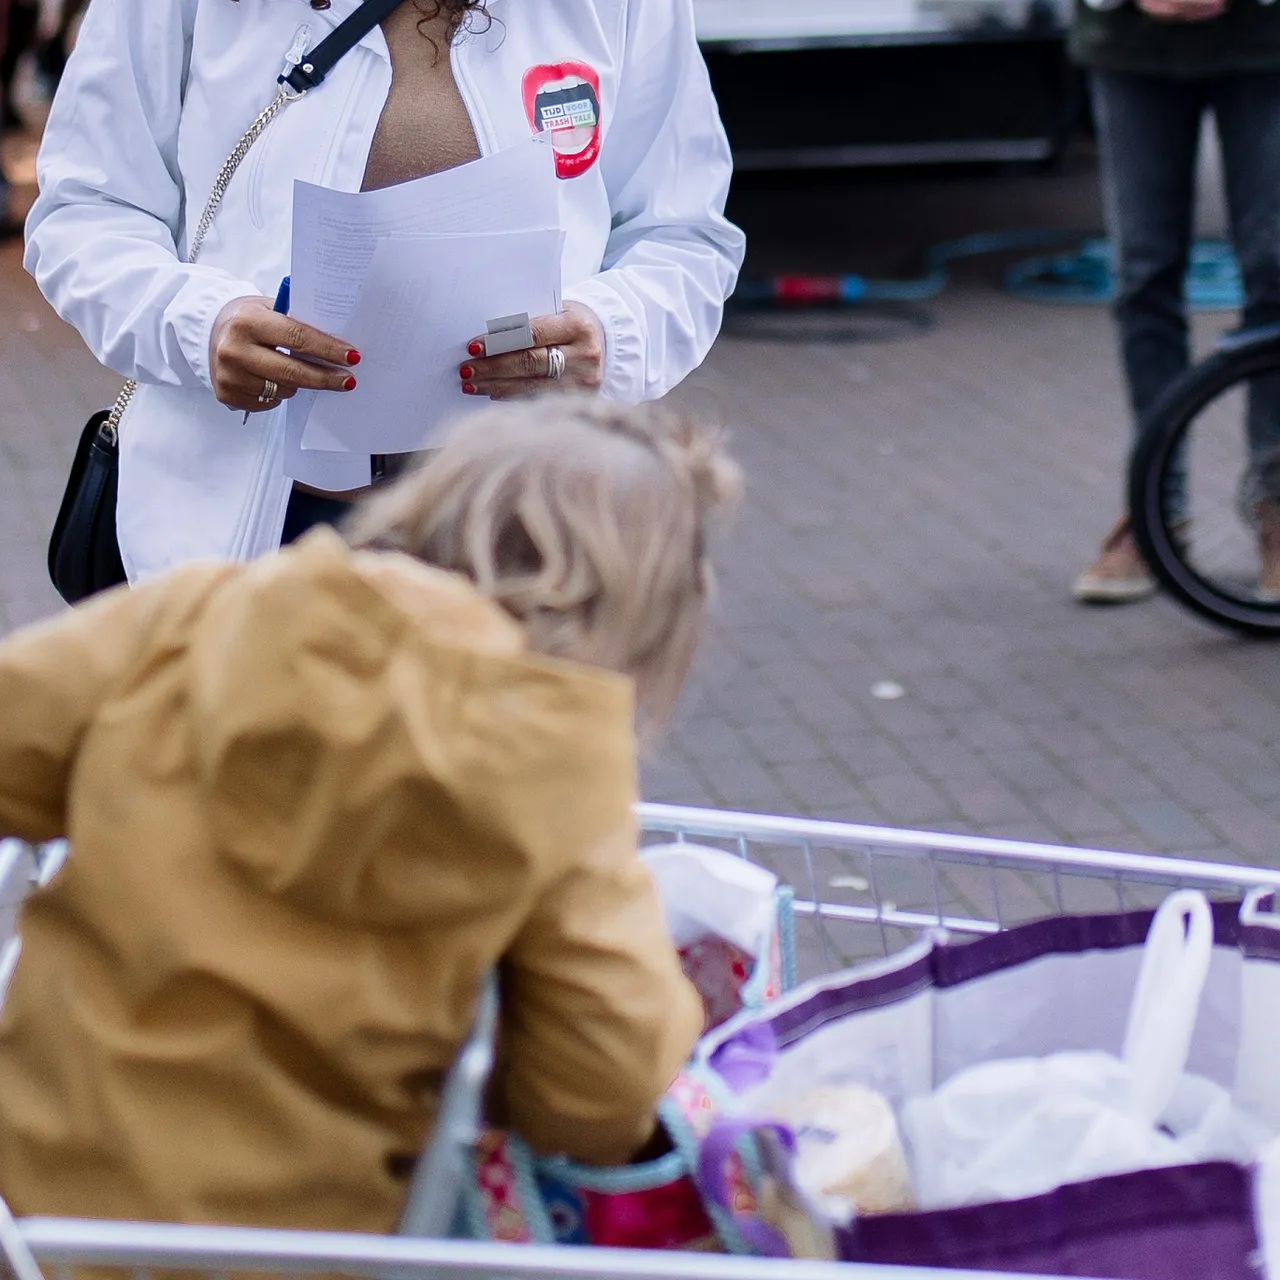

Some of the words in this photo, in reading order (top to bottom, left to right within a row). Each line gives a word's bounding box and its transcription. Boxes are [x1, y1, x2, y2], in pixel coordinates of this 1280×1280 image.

[543, 107, 561, 116] TIJD
[565, 102, 589, 111] VOOR
[545, 117, 570, 128] TRASH
[573, 113, 592, 123] TALK
